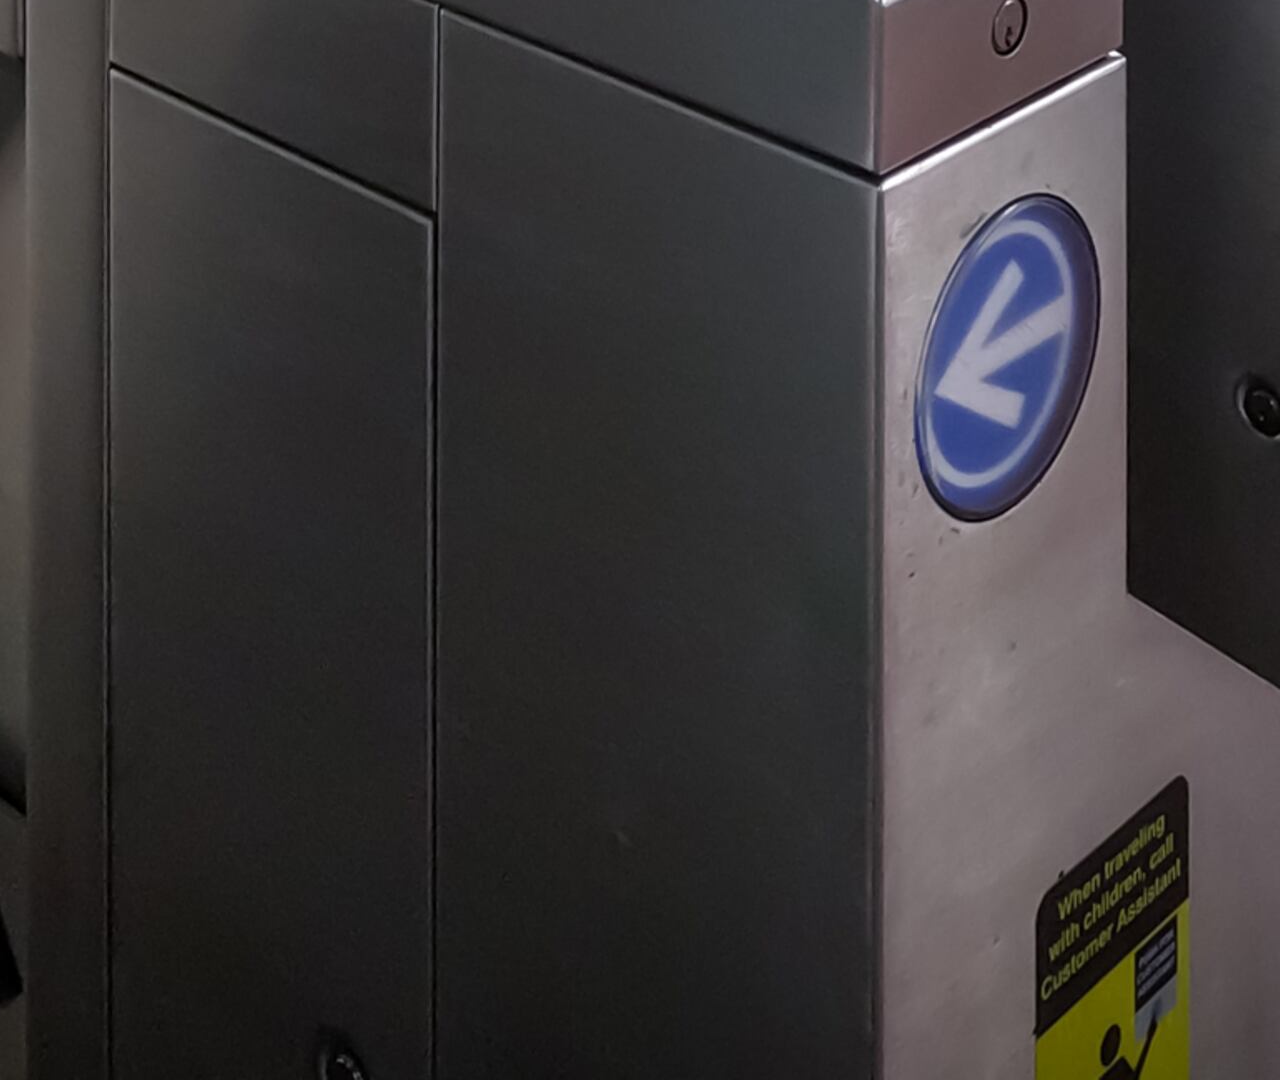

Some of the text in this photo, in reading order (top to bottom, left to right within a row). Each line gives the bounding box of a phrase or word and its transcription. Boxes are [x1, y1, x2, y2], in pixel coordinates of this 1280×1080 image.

[1041, 924, 1113, 1000] Customer
[1117, 858, 1181, 932] Assistant
[1049, 832, 1174, 961] with children, call
[1058, 815, 1165, 919] When traveling
